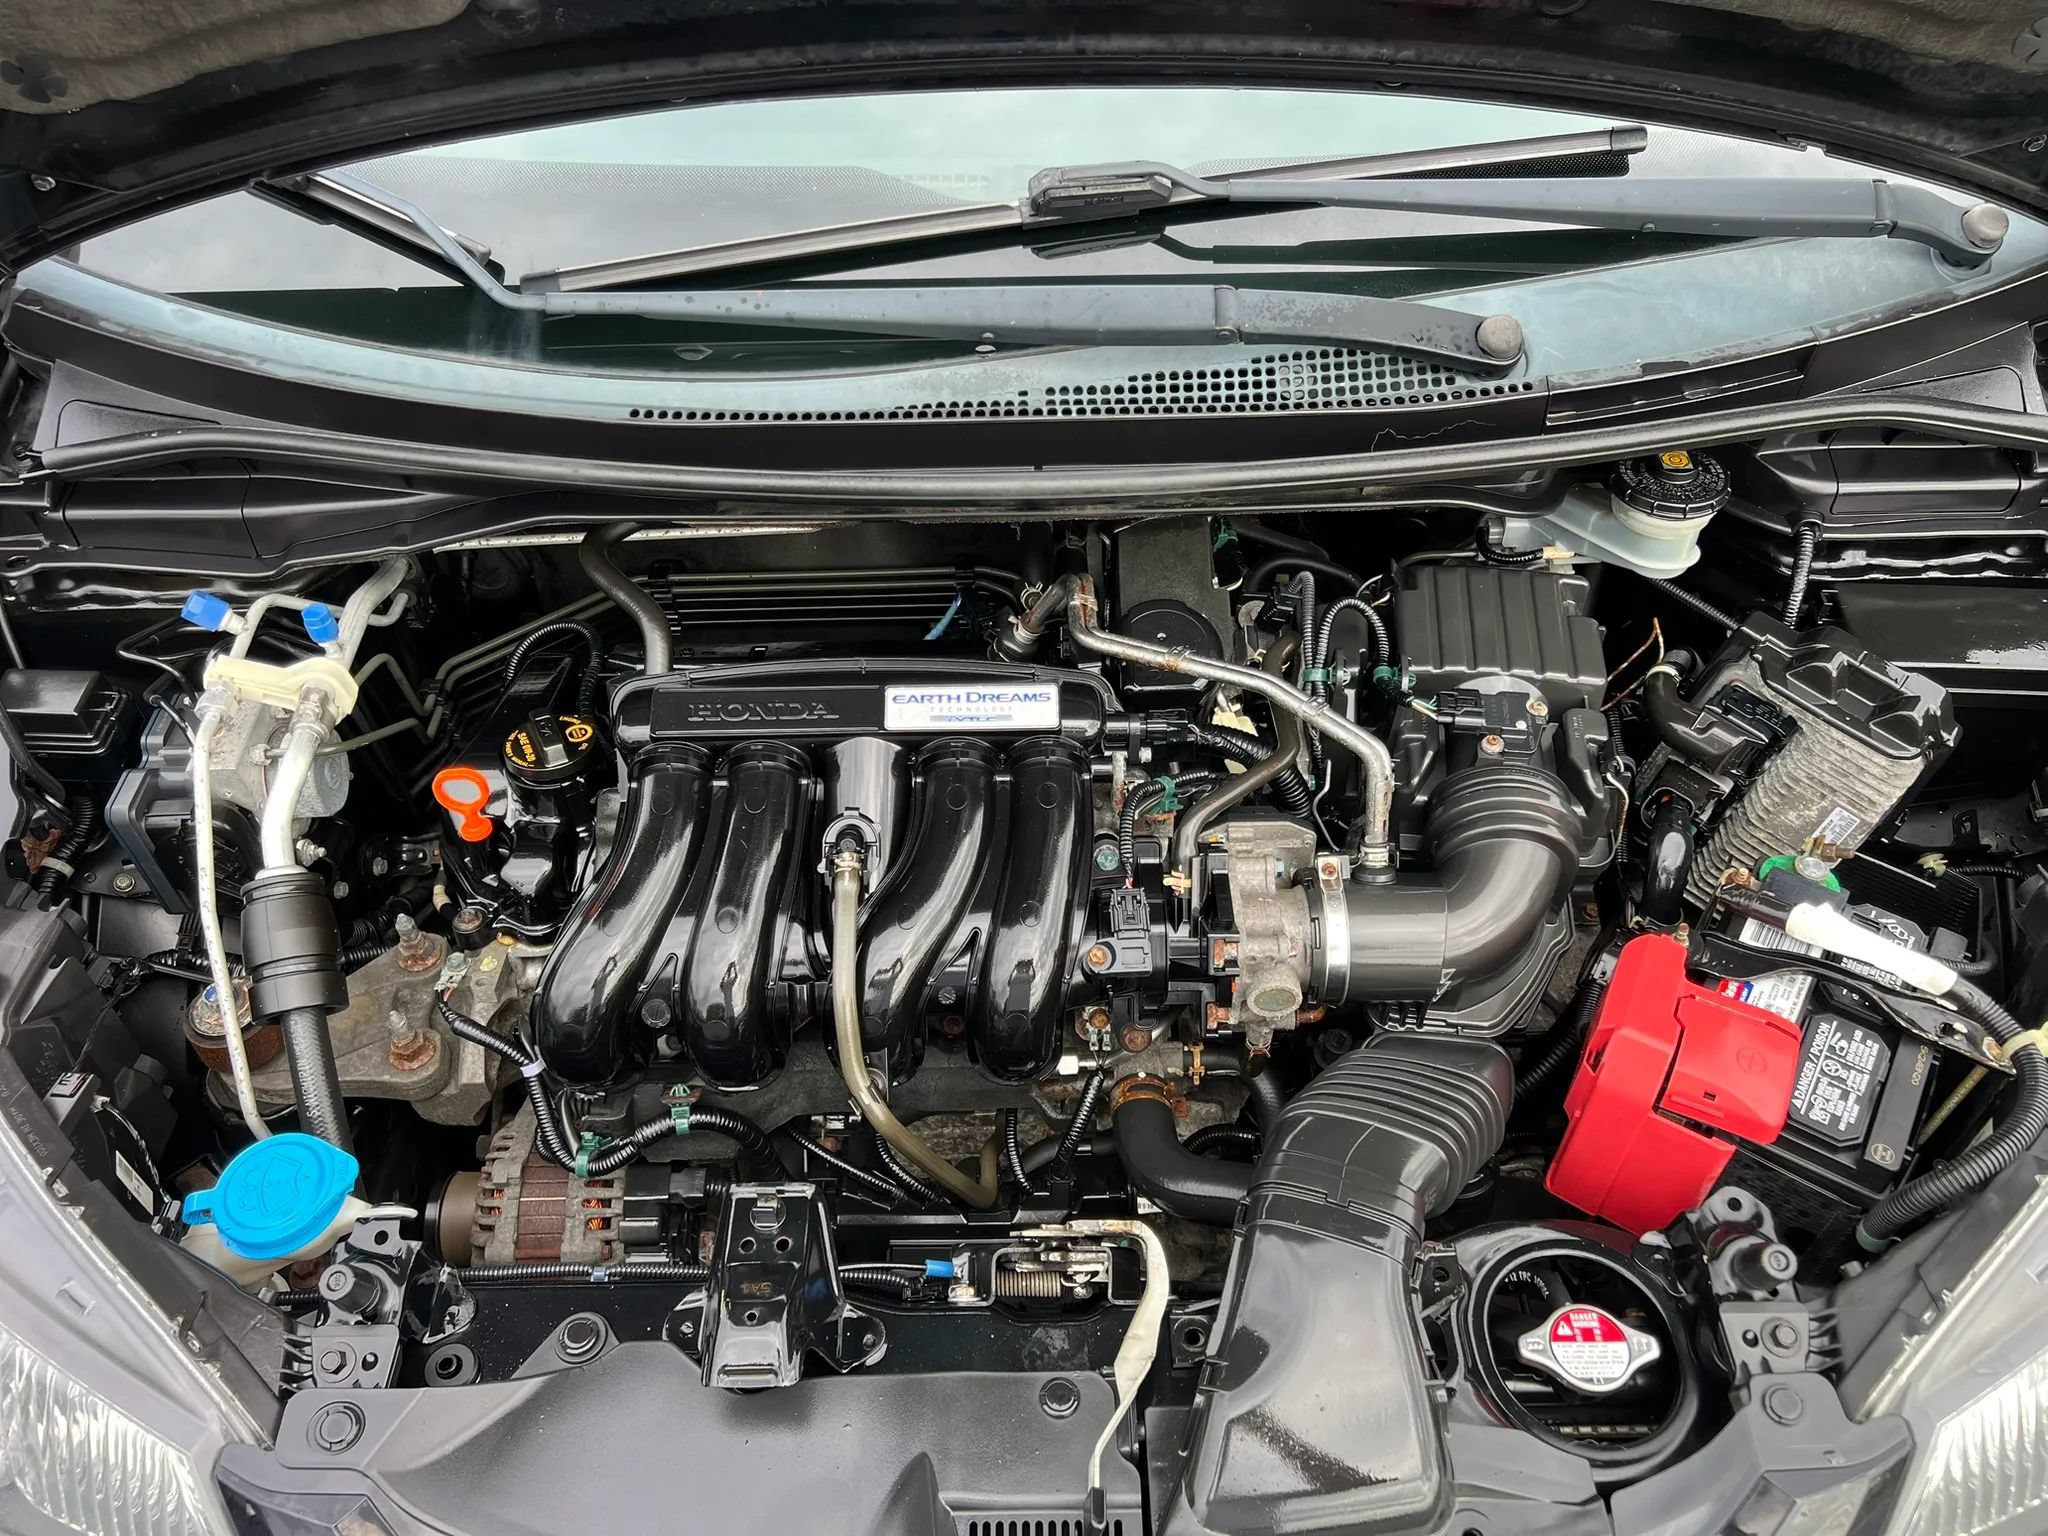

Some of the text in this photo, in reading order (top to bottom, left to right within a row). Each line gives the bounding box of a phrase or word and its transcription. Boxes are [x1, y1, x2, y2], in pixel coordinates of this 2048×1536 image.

[892, 691, 1052, 705] EARTH DREAMS
[688, 702, 840, 722] HONDA
[517, 732, 529, 745] SAE
[1794, 1061, 1816, 1098] DANGER
[1810, 1021, 1830, 1055] POISON
[8, 1105, 48, 1157] MADE IN MEXICO
